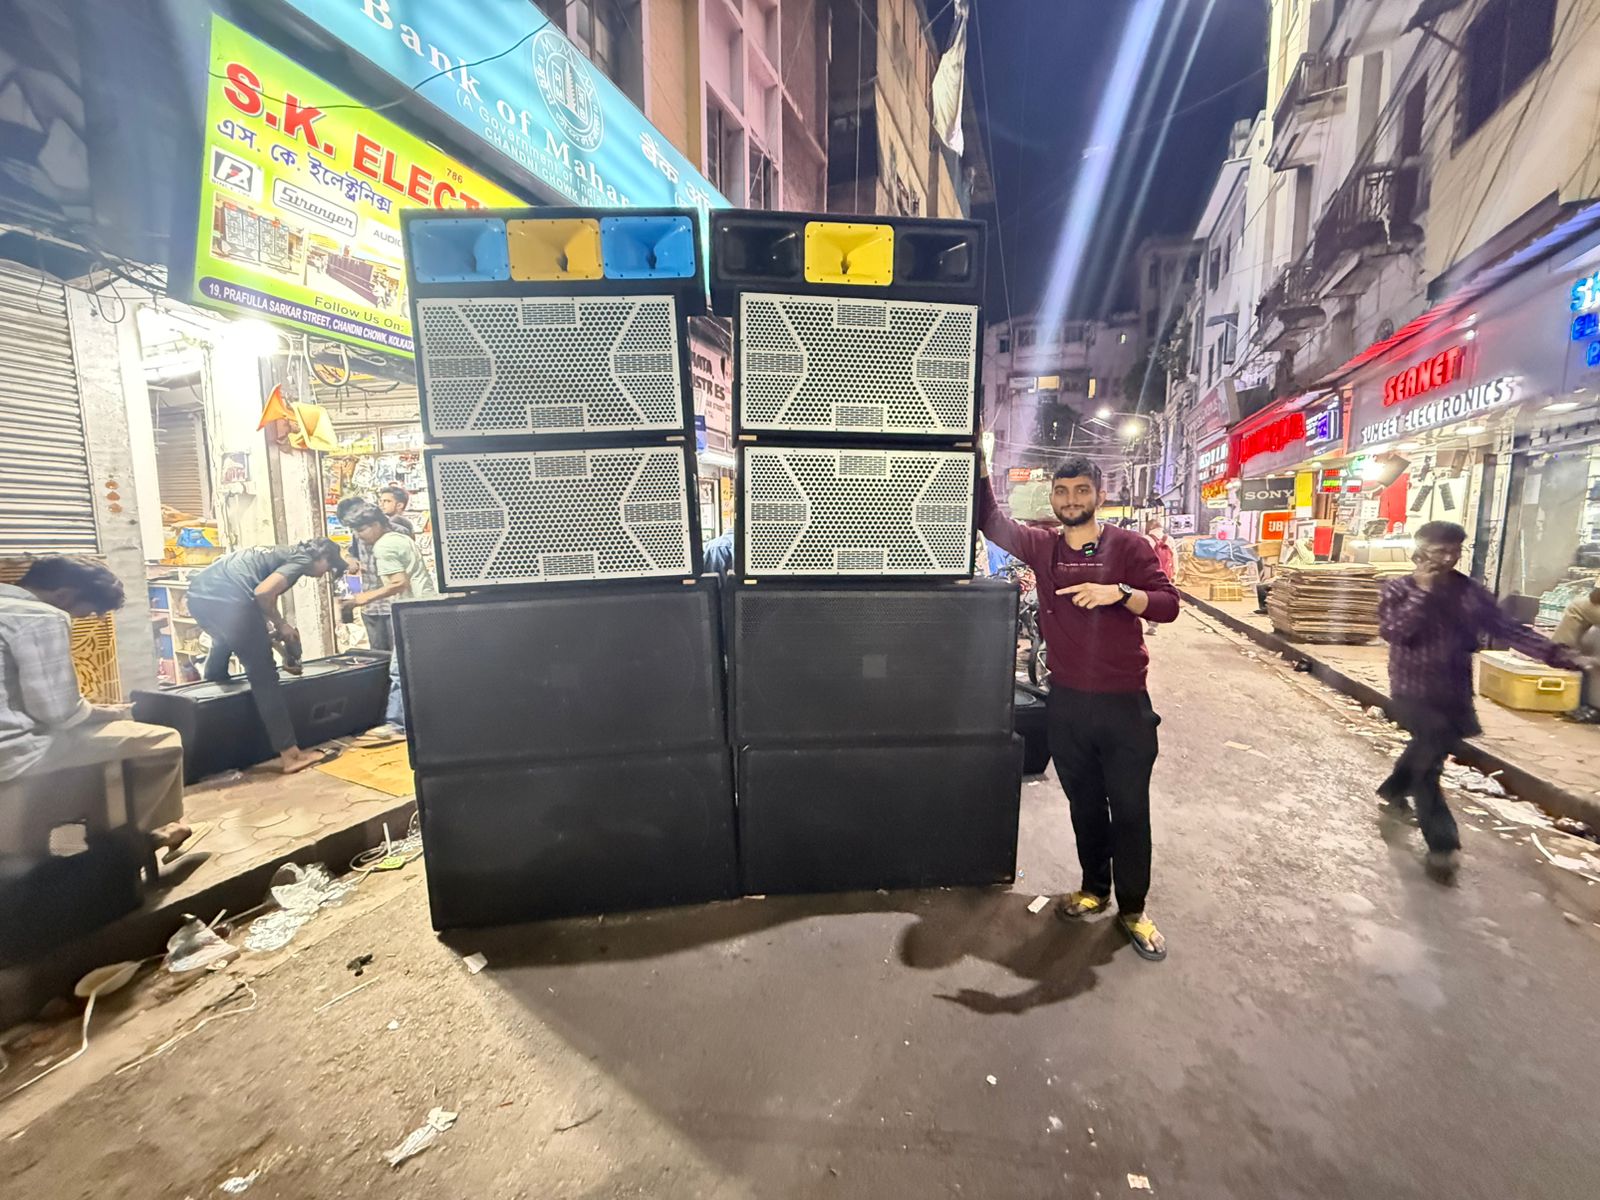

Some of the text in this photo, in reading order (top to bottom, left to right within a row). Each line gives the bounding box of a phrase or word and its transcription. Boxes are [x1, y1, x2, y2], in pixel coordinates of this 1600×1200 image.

[360, 0, 483, 104] Bank
[497, 100, 532, 137] of
[224, 63, 335, 157] S.K.
[456, 88, 474, 113] (A
[479, 106, 562, 173] Government
[563, 170, 573, 183] of
[446, 168, 463, 184] 786
[484, 127, 538, 173] CHANDNI
[541, 167, 579, 200] CHOWK
[209, 283, 222, 299] 19,
[223, 286, 268, 311] PRAFULLA
[269, 301, 301, 319] SARKAR
[302, 310, 332, 330] STREET,
[333, 319, 363, 336] CHANDNI
[314, 295, 404, 332] Follow Us On:
[1361, 415, 1400, 444] SUMEET
[1401, 377, 1515, 432] ELECTRONICS
[1245, 489, 1294, 501] SONY
